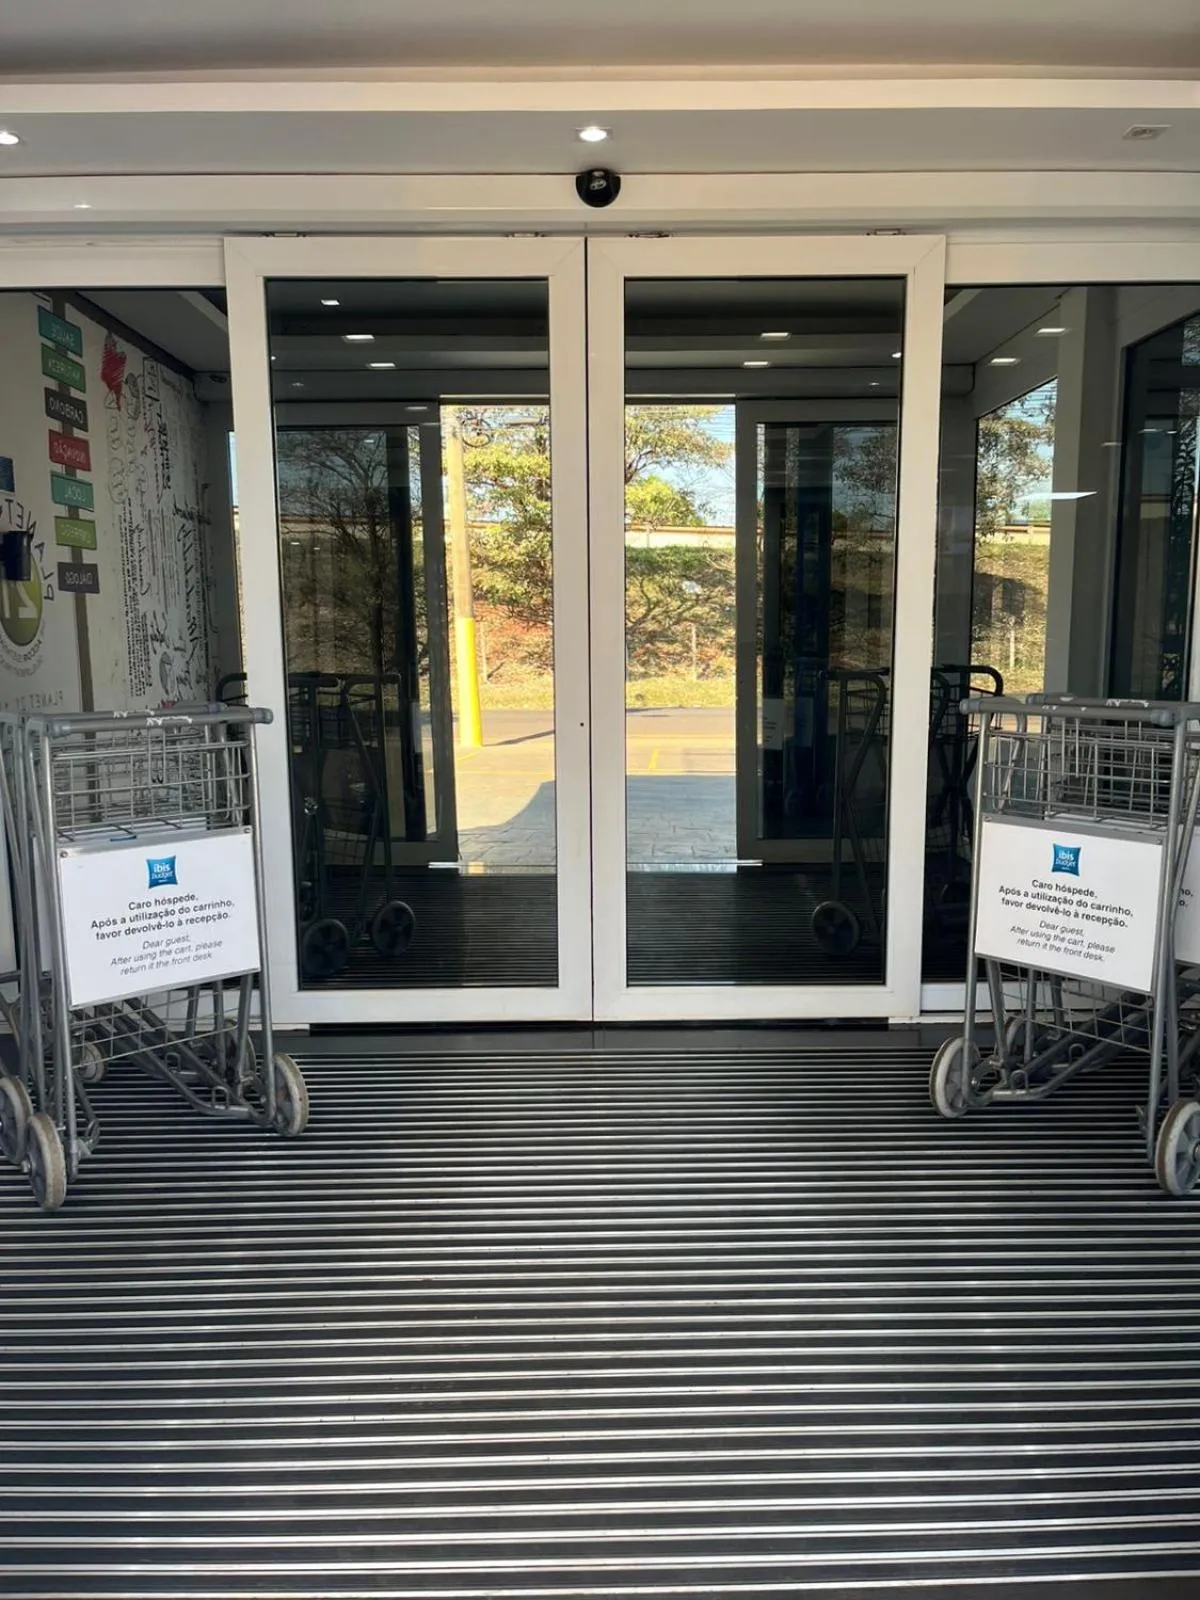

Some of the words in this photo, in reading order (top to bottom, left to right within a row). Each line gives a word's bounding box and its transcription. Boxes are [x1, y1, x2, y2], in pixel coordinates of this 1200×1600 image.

[1058, 850, 1074, 860] ibis
[153, 863, 171, 873] ibis
[1031, 879, 1053, 890] Caro
[128, 901, 152, 911] Caro
[998, 885, 1021, 897] Após
[1023, 890, 1029, 898] a
[1031, 892, 1074, 906] utilização
[1076, 899, 1088, 908] do
[91, 917, 118, 930] Após
[129, 908, 176, 923] utilização
[178, 905, 191, 915] do
[1001, 897, 1024, 907] favor
[1025, 901, 1072, 917] devolvê-lo
[1073, 909, 1079, 919] à
[1081, 912, 1129, 928] recepção.
[96, 929, 122, 940] favor
[124, 920, 175, 936] devolvê-lo
[177, 918, 183, 927] à
[1039, 919, 1060, 930] Dear
[142, 939, 164, 950] Dear
[1010, 926, 1029, 935] After
[1029, 931, 1052, 941] using
[1053, 934, 1066, 943] the
[1087, 941, 1116, 953] please
[1016, 938, 1041, 948] return
[1049, 943, 1062, 953] the
[1063, 946, 1083, 956] front
[110, 956, 132, 967] After
[133, 952, 157, 962] using
[159, 948, 172, 958] the
[195, 940, 223, 952] please
[120, 964, 147, 976] return
[156, 959, 170, 969] the
[171, 955, 191, 965] front
